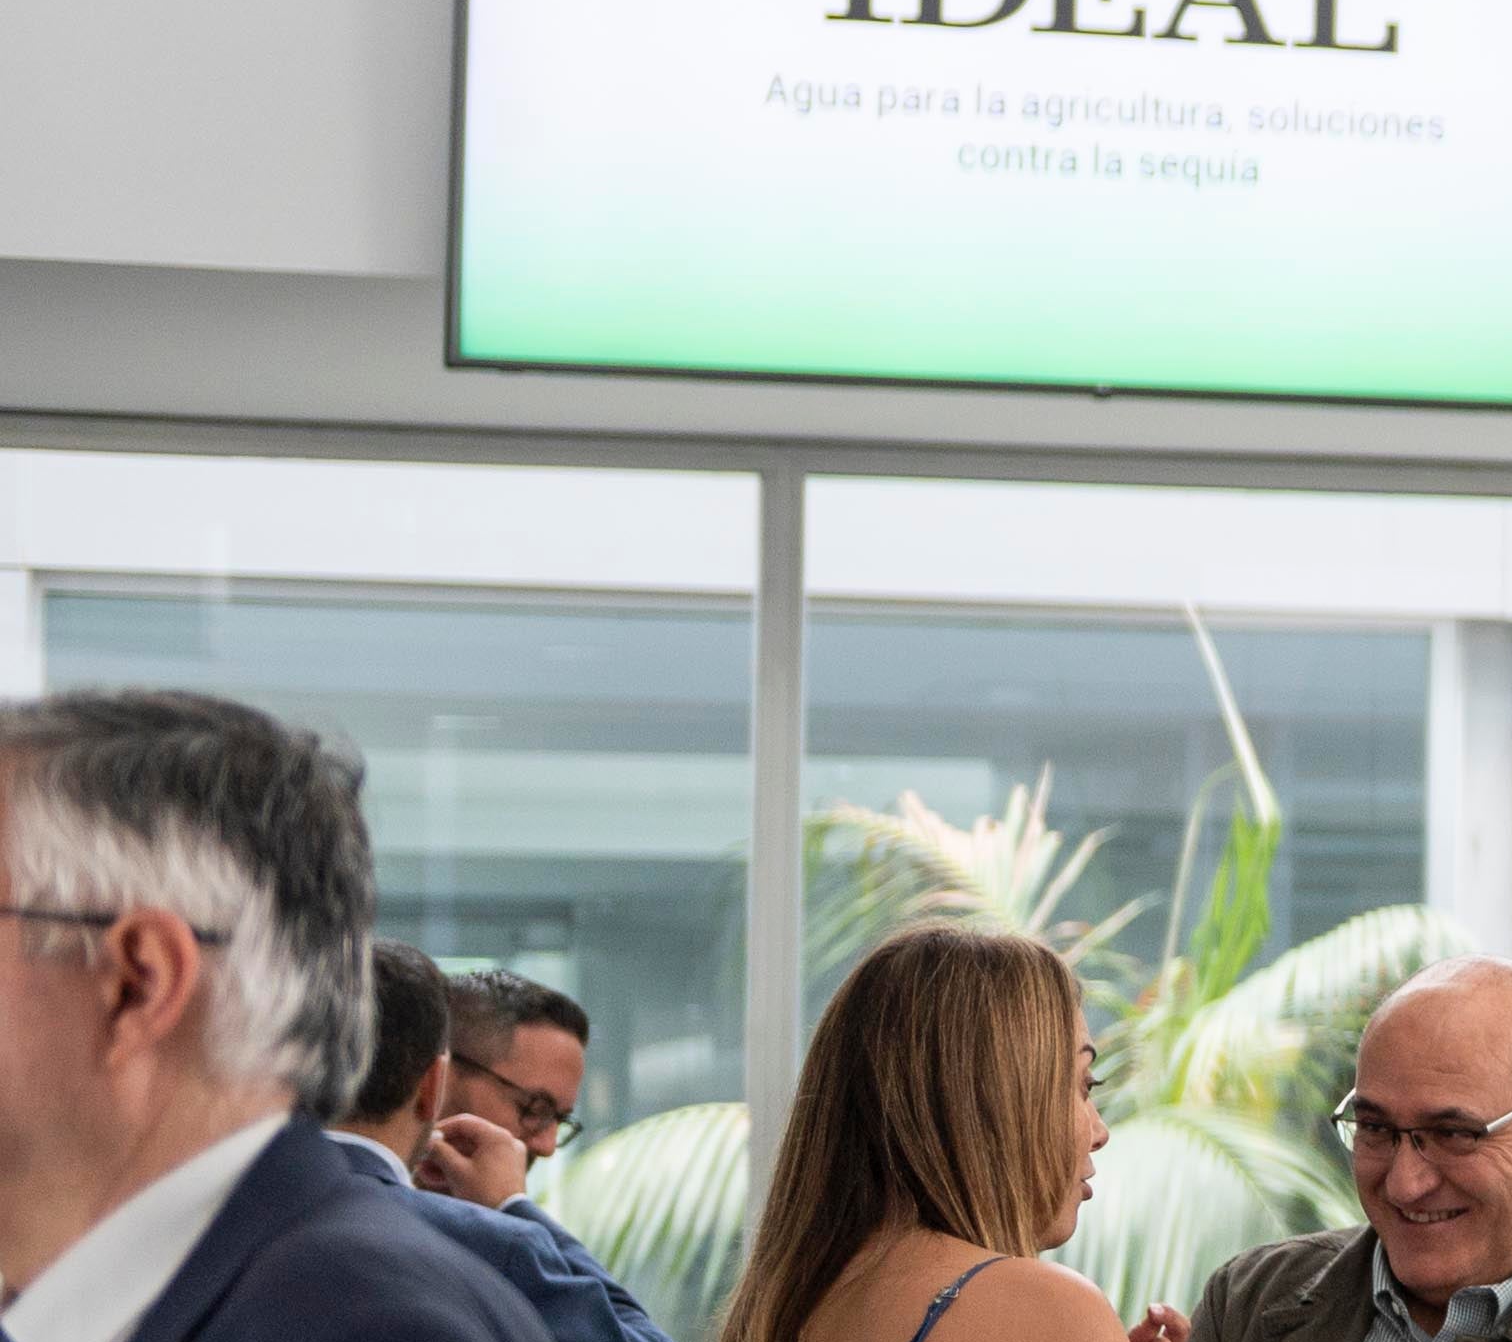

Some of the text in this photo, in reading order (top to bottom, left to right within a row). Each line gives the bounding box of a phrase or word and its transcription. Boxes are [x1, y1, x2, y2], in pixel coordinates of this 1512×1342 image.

[765, 73, 1445, 140] Agua para la agricultura, soluciones
[957, 142, 1078, 174] contra
[1094, 142, 1123, 177] la
